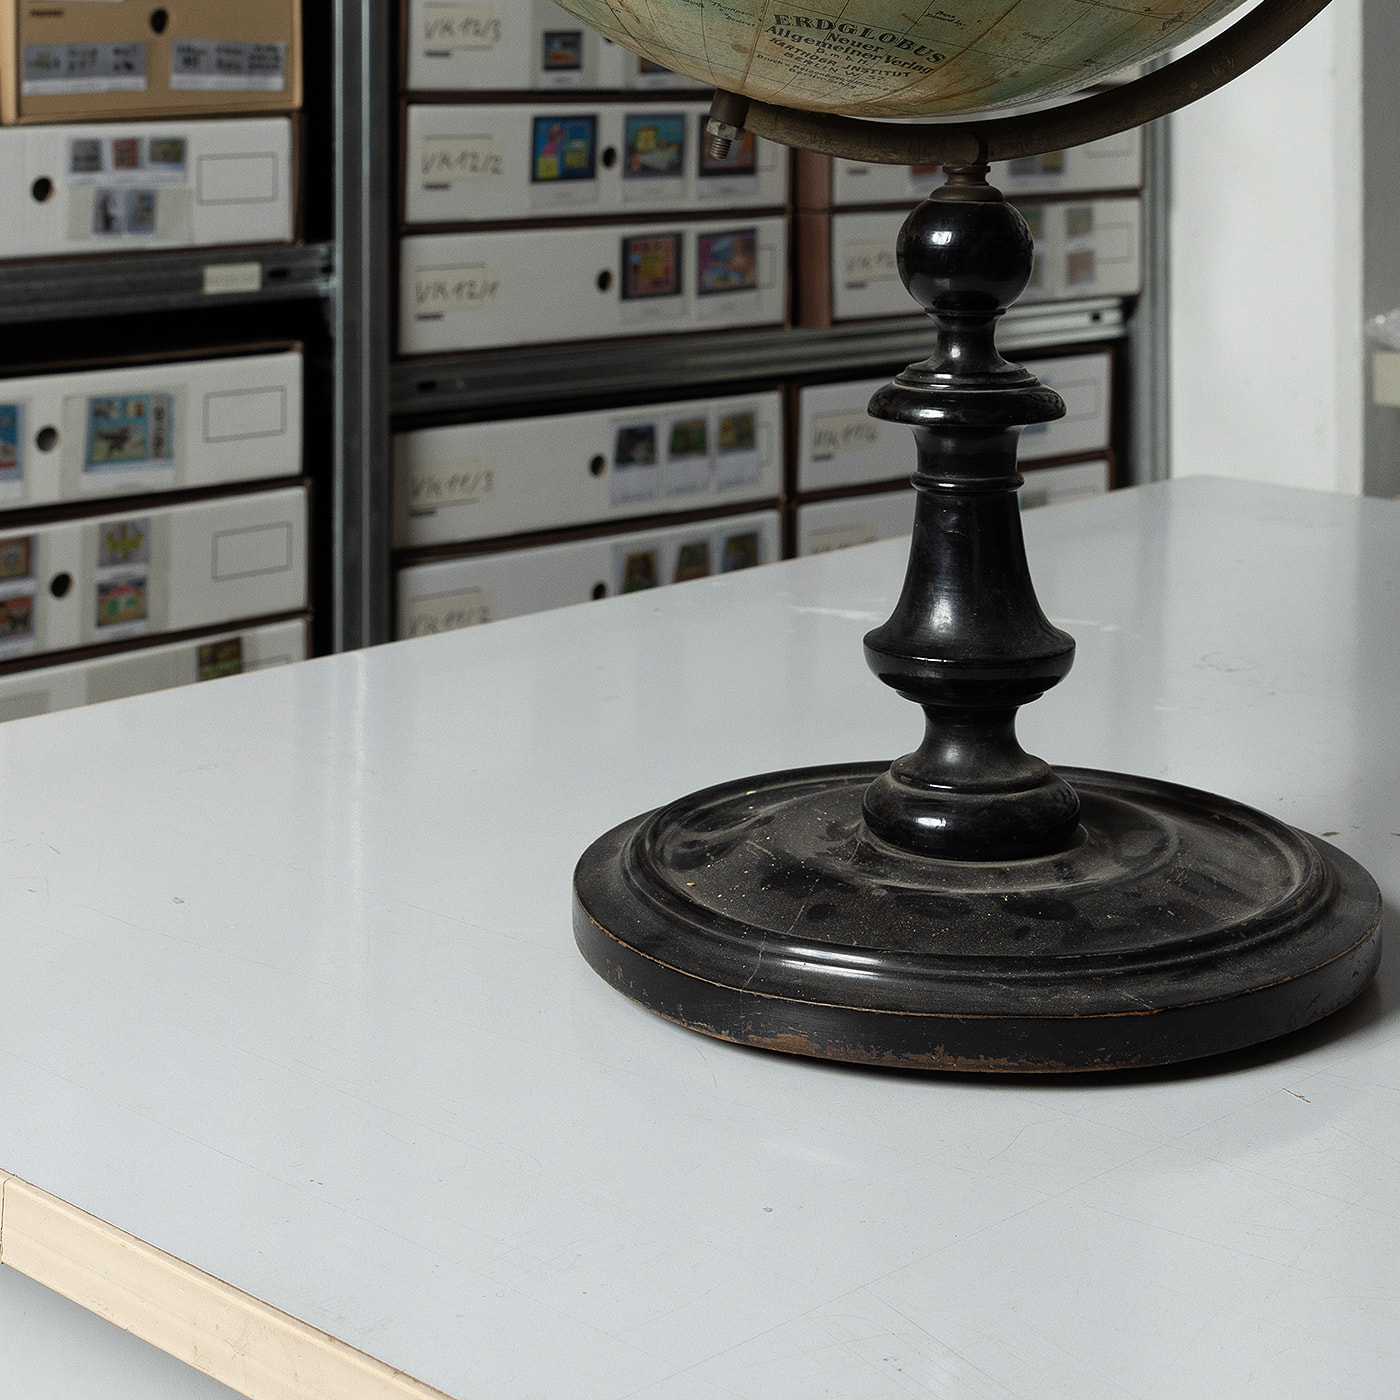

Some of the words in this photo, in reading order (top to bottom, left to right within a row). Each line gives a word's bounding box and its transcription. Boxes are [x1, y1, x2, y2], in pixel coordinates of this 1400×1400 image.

[764, 26, 883, 62] Allgemeiner
[884, 54, 935, 75] Verlag
[773, 13, 946, 64] ERDGLOBUS
[827, 33, 884, 54] Neuer
